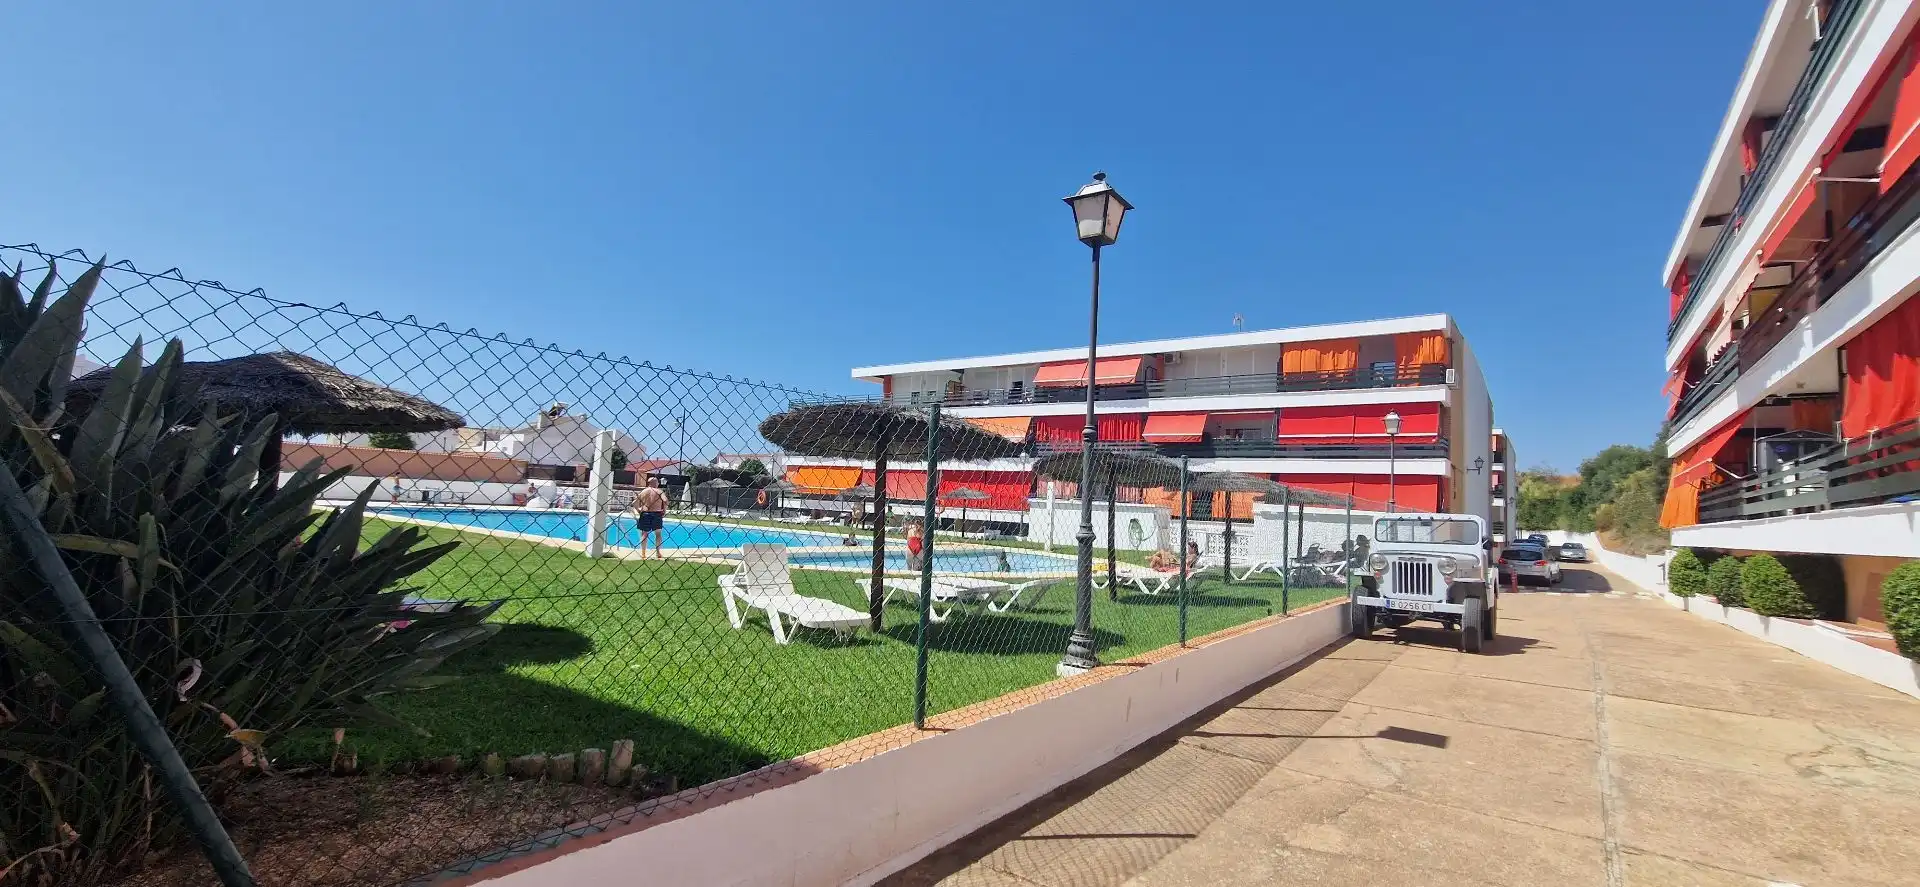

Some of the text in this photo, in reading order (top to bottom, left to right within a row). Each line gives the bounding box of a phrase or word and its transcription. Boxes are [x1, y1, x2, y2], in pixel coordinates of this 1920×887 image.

[1390, 600, 1433, 611] B 0256 CT
